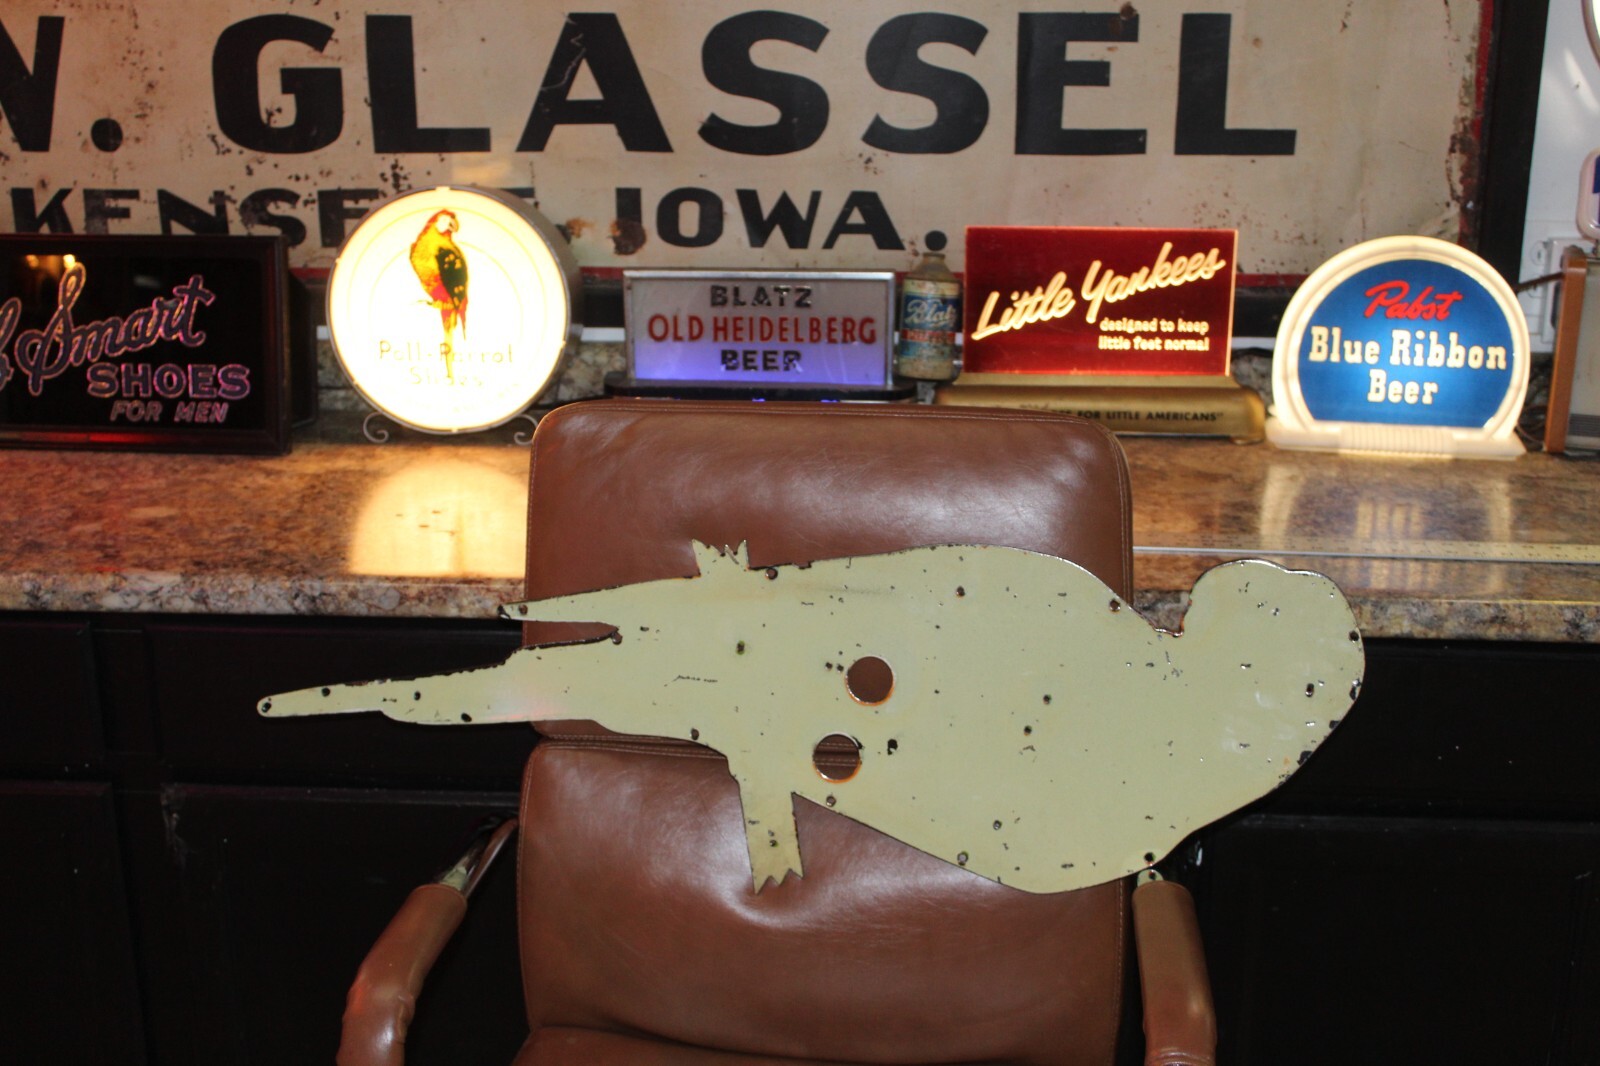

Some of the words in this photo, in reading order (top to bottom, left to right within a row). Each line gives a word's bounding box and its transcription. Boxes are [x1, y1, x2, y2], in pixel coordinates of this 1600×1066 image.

[211, 10, 1297, 155] GLASSEL
[710, 285, 812, 308] BLATZ
[971, 271, 1076, 341] Little
[1081, 241, 1226, 324] Yankees
[1364, 280, 1463, 320] Pabst
[14, 262, 216, 396] Smart
[647, 314, 704, 342] OLD
[712, 315, 877, 345] HEIDELBERG
[1099, 335, 1131, 350] little
[1133, 335, 1162, 350] feet
[1164, 336, 1210, 351] normal
[1100, 317, 1157, 334] designed
[1160, 318, 1174, 333] to
[1177, 318, 1210, 336] keep
[720, 349, 803, 372] BEER
[1308, 325, 1380, 365] Blue
[1389, 329, 1507, 370] Ribbon
[87, 362, 250, 400] SHOES
[1367, 368, 1438, 405] Beer
[109, 400, 163, 422] FOR
[173, 401, 229, 423] MEN
[1077, 410, 1100, 420] FOR
[1106, 410, 1140, 420] LITTLE
